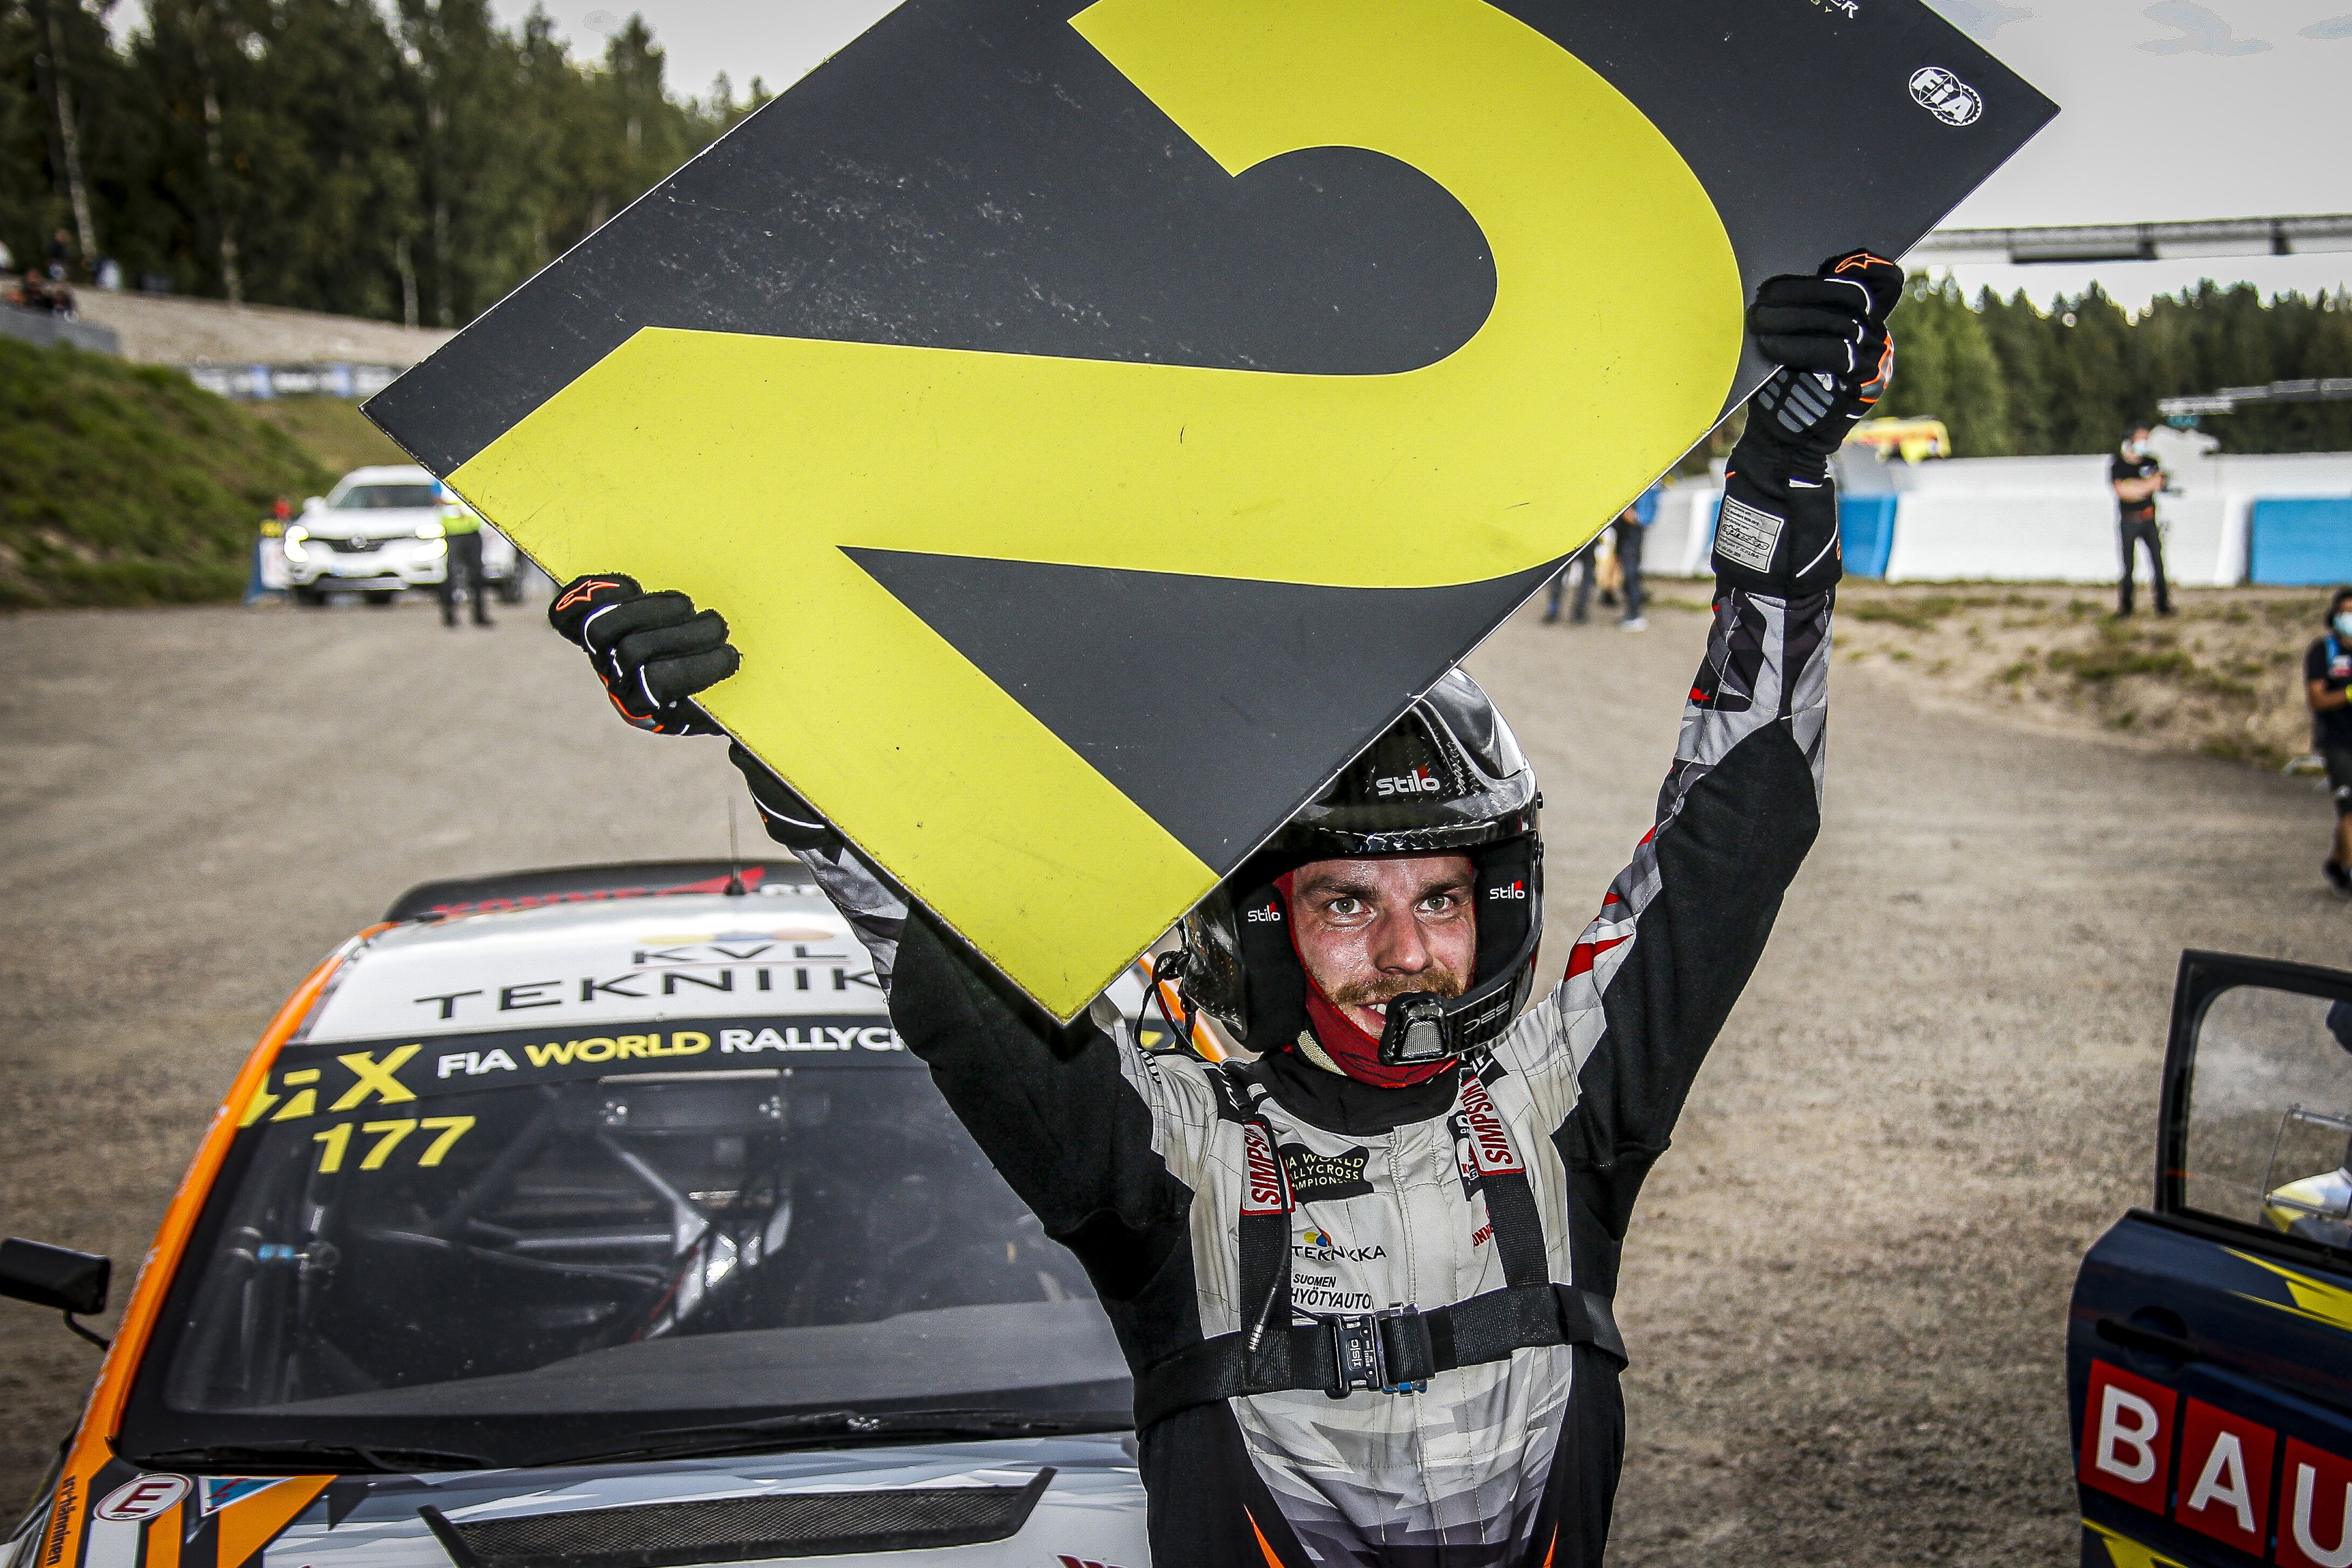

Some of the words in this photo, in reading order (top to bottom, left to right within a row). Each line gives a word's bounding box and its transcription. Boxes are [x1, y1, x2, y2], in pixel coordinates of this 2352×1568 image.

[1911, 67, 1975, 123] FIA
[451, 0, 1744, 1022] 2
[1375, 767, 1440, 796] Stilo
[1489, 881, 1525, 900] Stilo
[1247, 903, 1281, 922] Stilo
[633, 944, 849, 964] KVL
[437, 1049, 518, 1079] FIA
[524, 1031, 712, 1066] WORLD
[1460, 1080, 1514, 1165] SIMPSON
[312, 1115, 477, 1174] 177
[1291, 1164, 1359, 1180] LLYCROSS
[1293, 1273, 1336, 1288] SUOMEN
[109, 1482, 176, 1513] E
